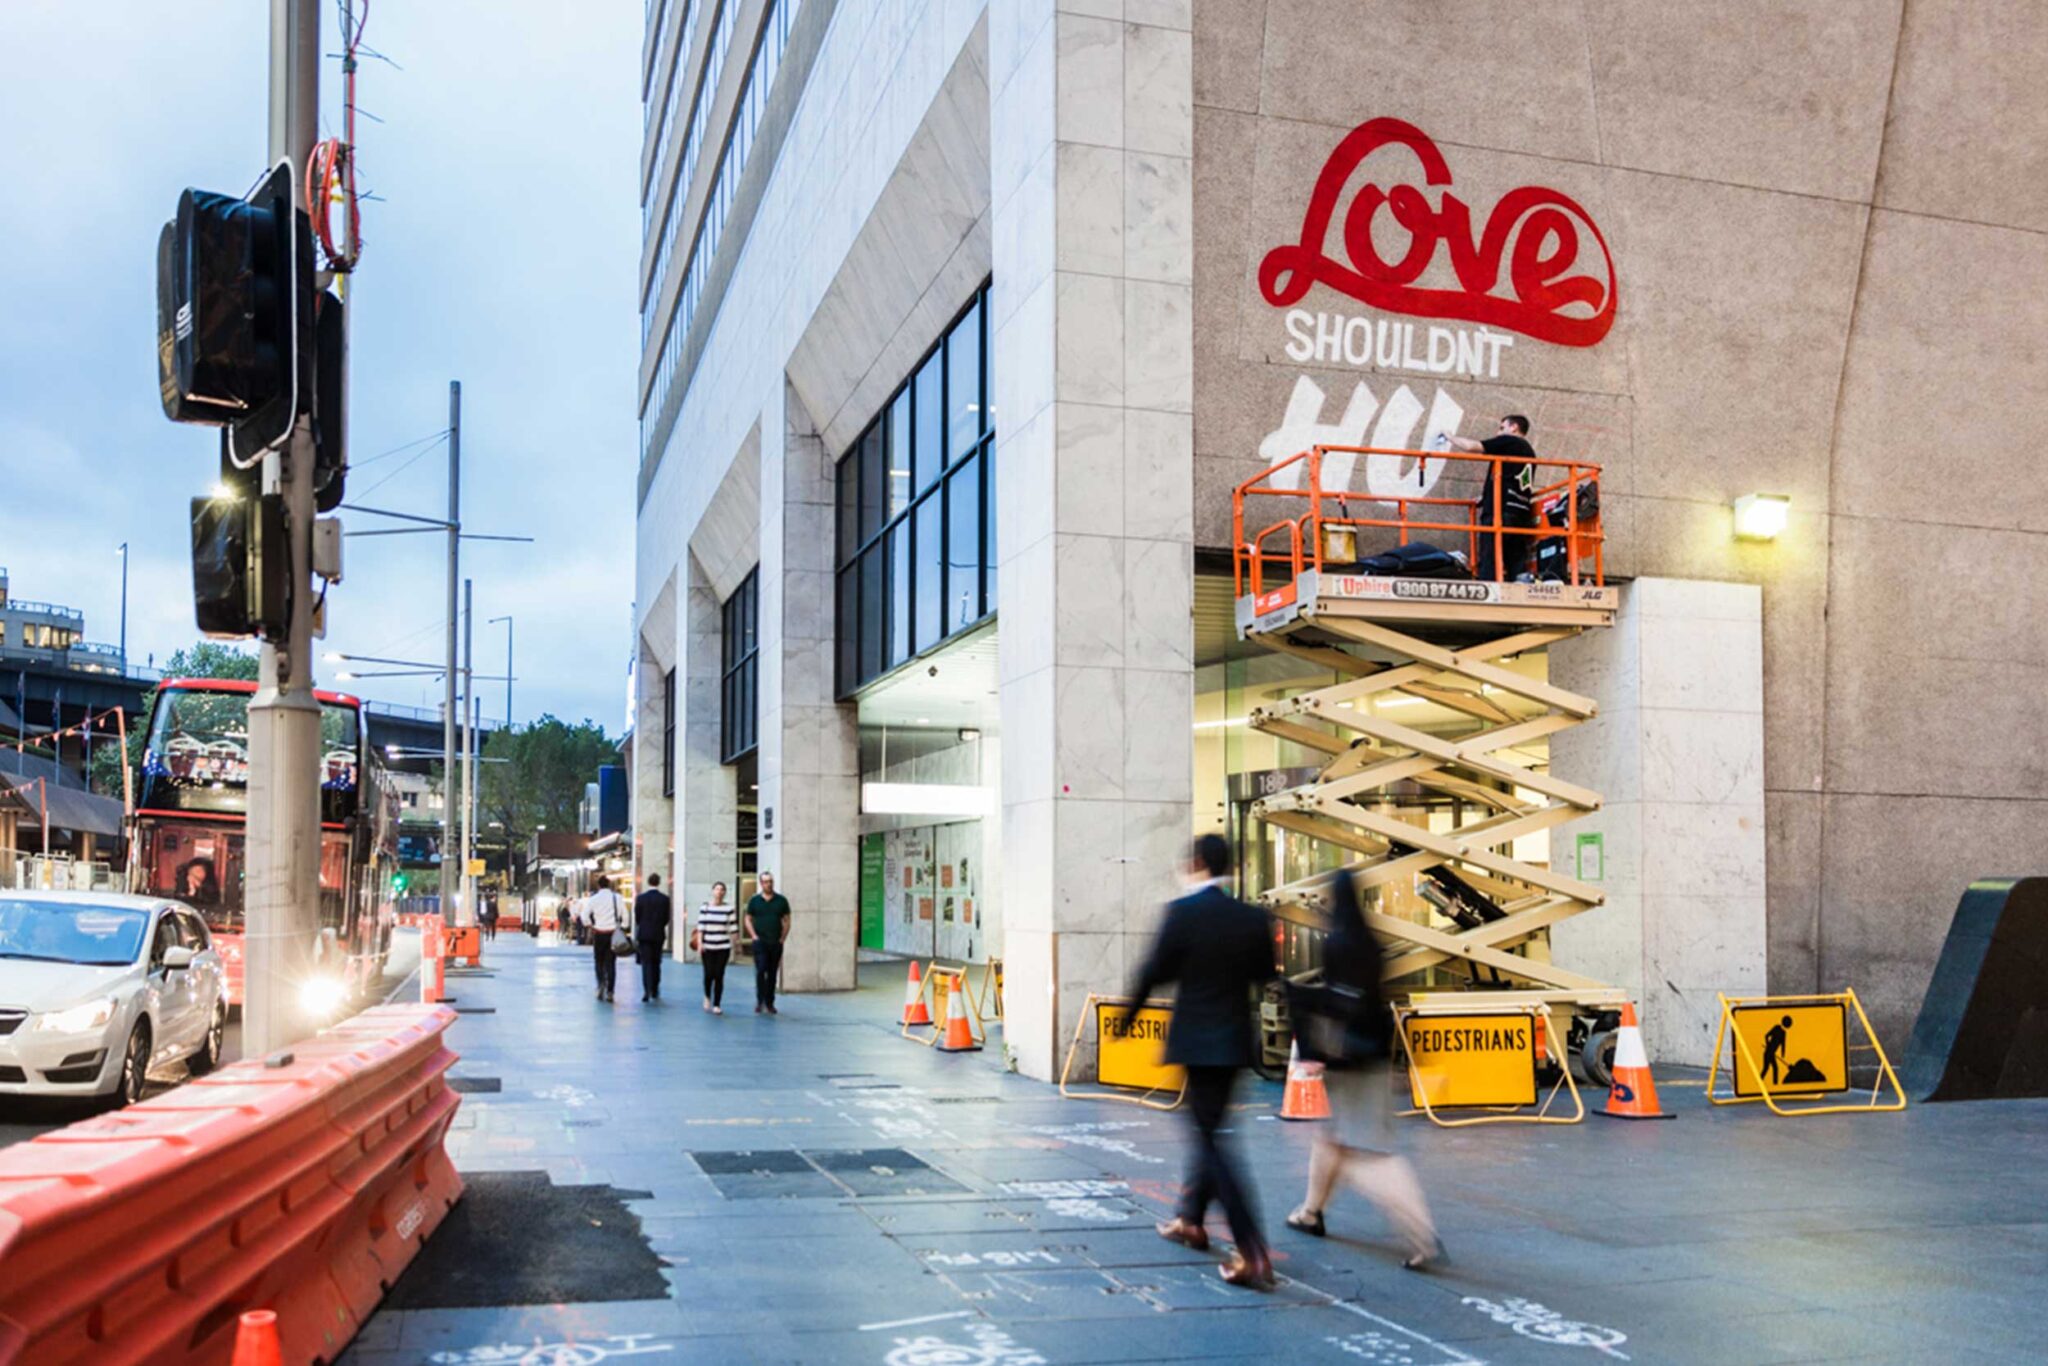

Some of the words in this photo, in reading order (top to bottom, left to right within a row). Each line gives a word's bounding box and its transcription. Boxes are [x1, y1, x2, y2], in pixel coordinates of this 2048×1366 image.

[1258, 116, 1618, 347] Love
[1285, 308, 1514, 378] SHOULDN'T
[1343, 577, 1390, 595] Uphire
[1396, 581, 1428, 597] 1300
[1581, 590, 1602, 600] JLG
[1103, 1016, 1167, 1041] PEDESTRI
[1411, 1027, 1527, 1054] PEDESTRIANS
